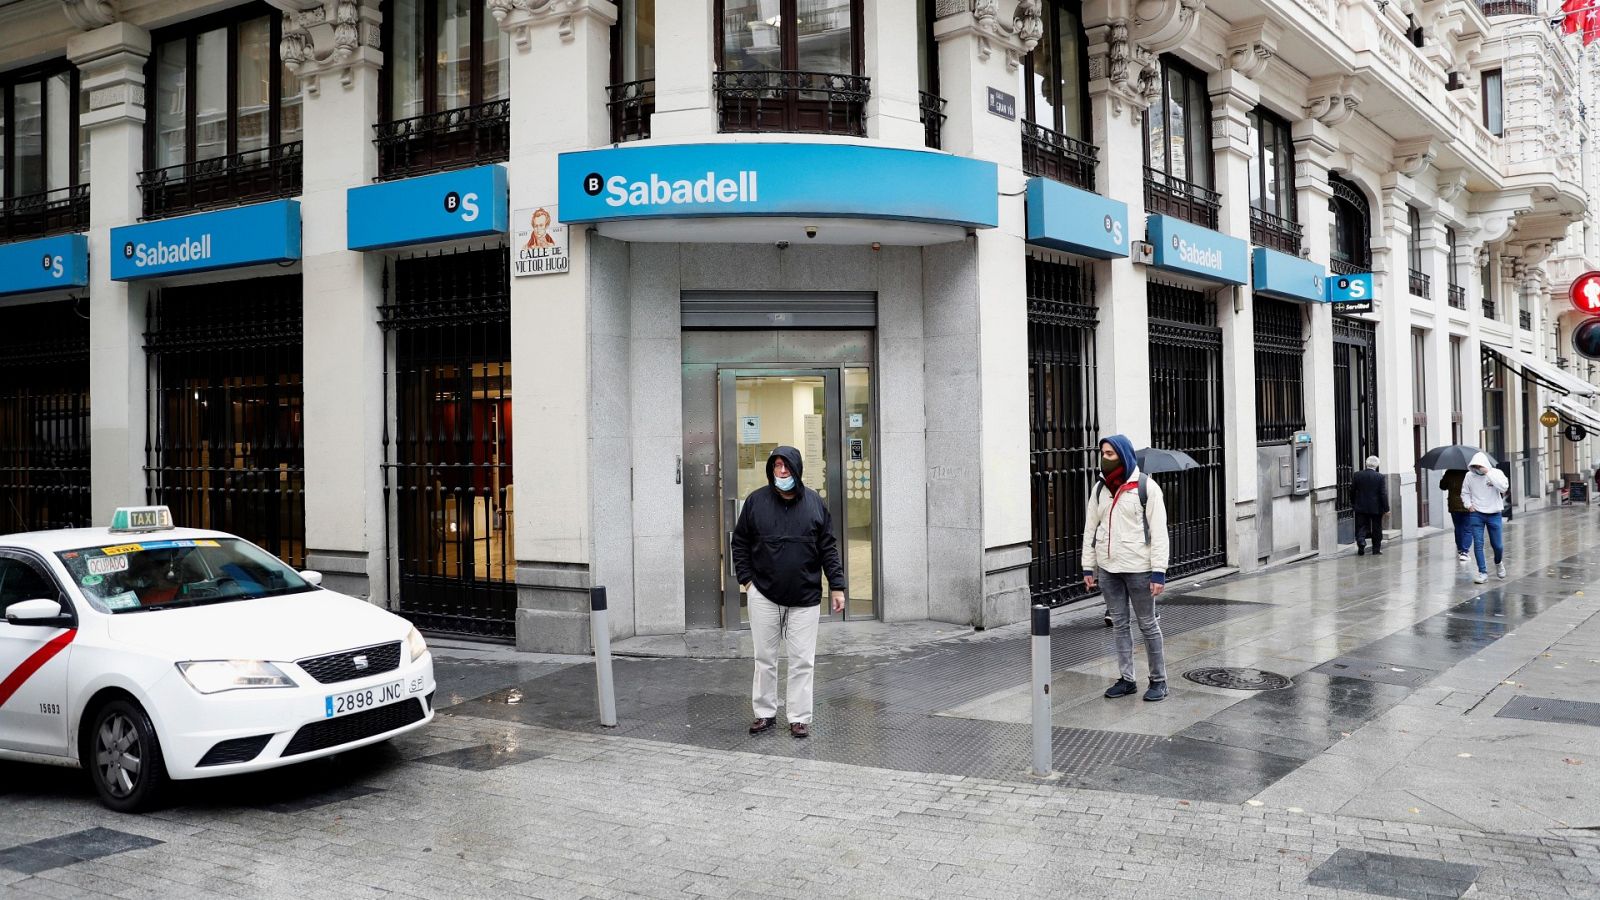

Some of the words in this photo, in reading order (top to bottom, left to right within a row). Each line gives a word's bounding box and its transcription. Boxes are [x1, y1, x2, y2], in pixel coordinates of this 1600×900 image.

[605, 170, 758, 207] Sabadell
[461, 192, 479, 222] S
[1113, 220, 1123, 246] S
[135, 233, 211, 267] Sabadell
[520, 247, 549, 260] CALLE
[552, 246, 562, 255] DE
[1179, 239, 1223, 271] Sabadell
[52, 255, 64, 278] S
[515, 259, 543, 274] VICTOR
[545, 256, 568, 271] HUGO
[1349, 279, 1365, 298] S
[131, 512, 156, 526] TAXI
[90, 556, 126, 573] OCUPADO
[39, 703, 60, 715] 15693
[336, 690, 374, 714] 2898
[378, 682, 401, 703] JNC
